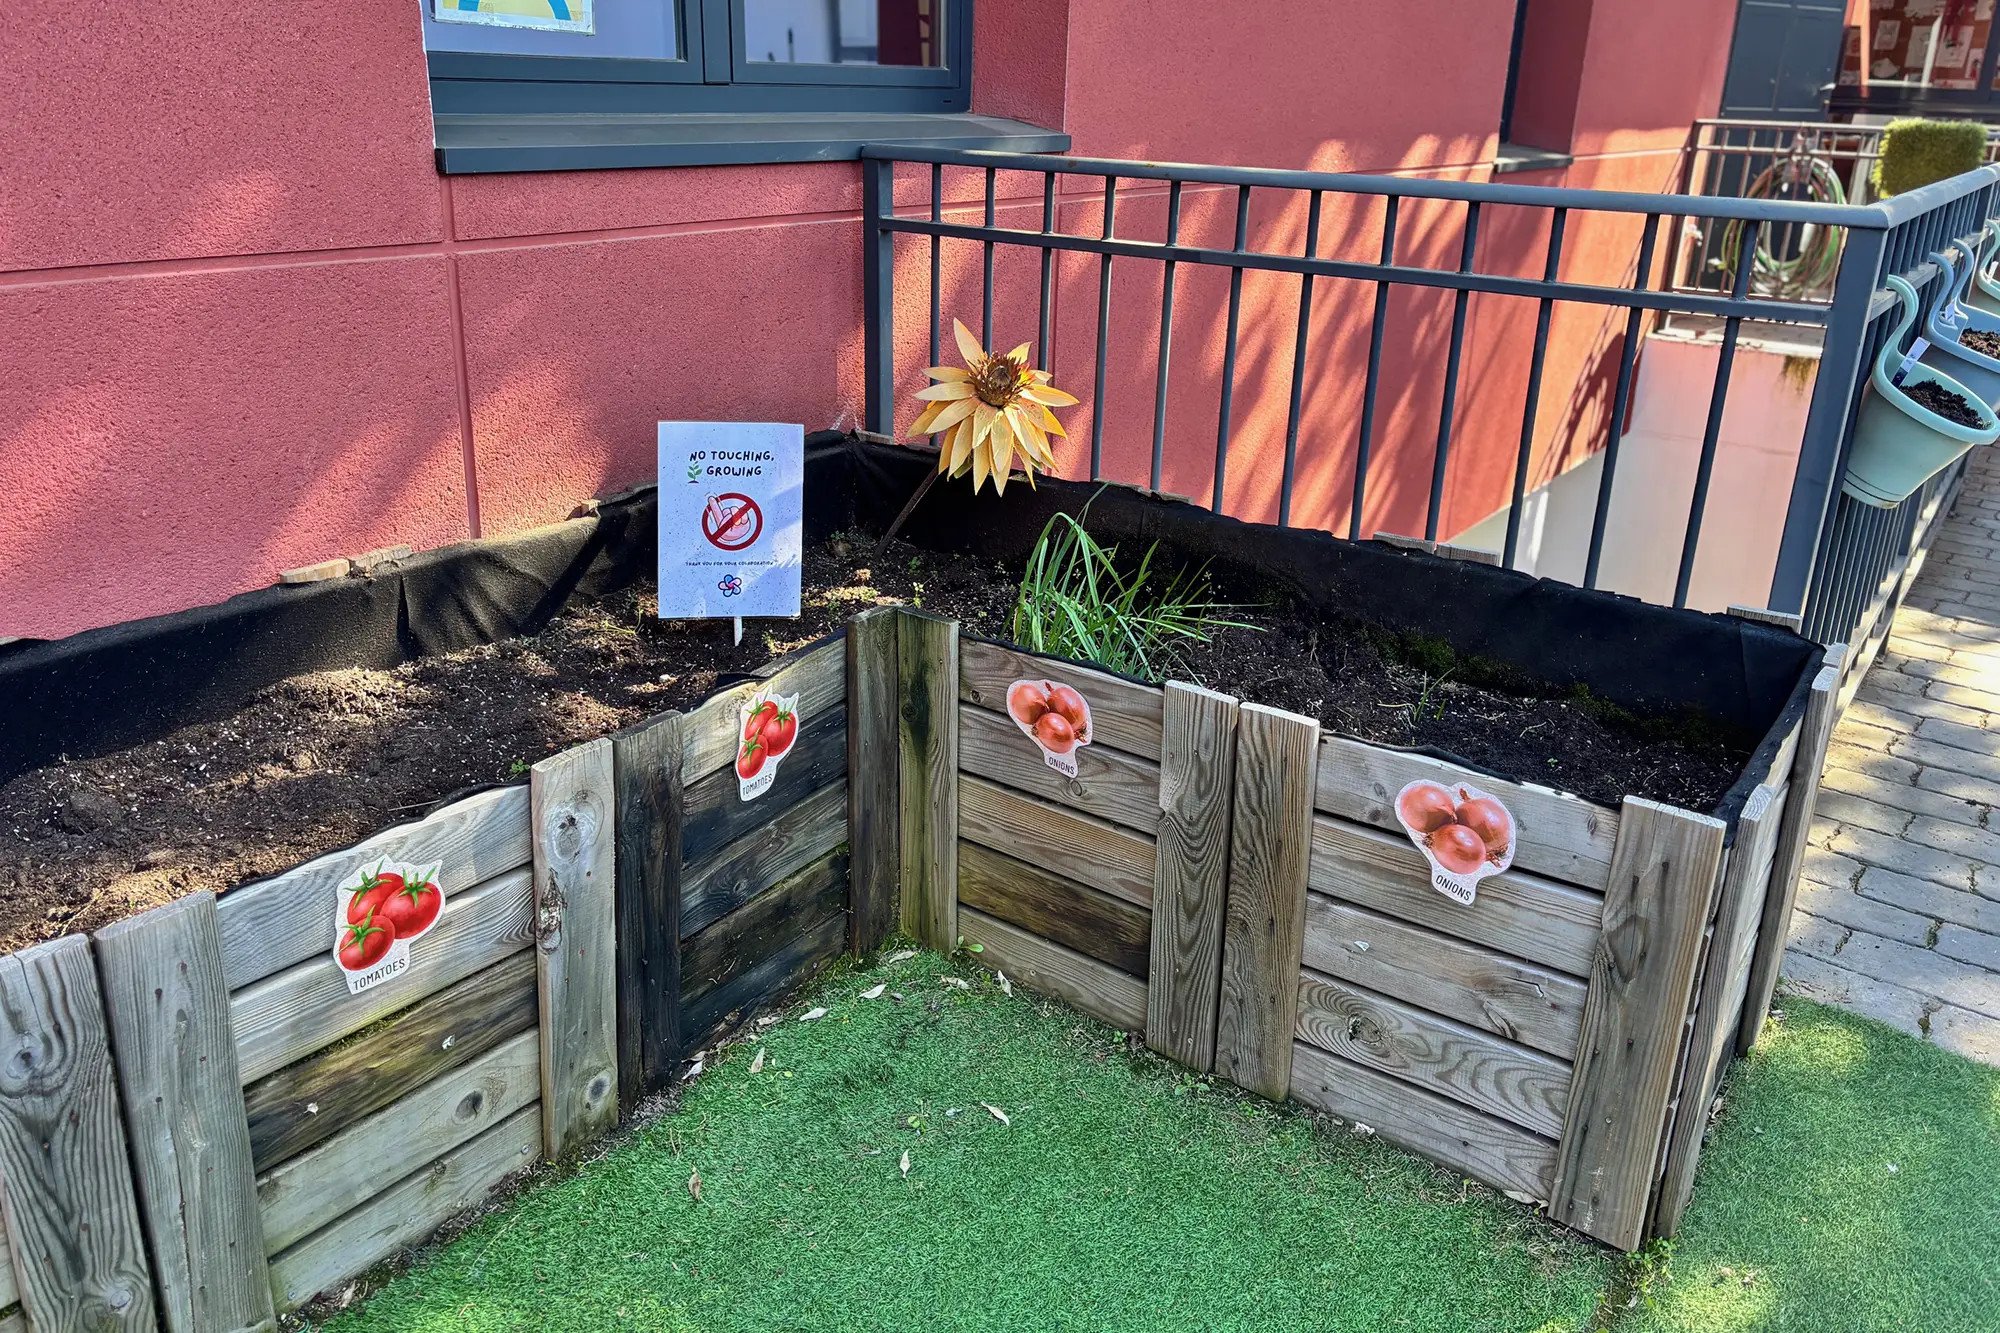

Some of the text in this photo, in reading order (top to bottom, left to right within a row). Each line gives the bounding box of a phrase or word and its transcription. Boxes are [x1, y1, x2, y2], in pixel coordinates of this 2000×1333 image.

[690, 451, 774, 462] NO TOUCHING,
[706, 466, 762, 477] GROWING
[1048, 757, 1075, 775] ONIONS
[742, 773, 772, 795] TOMATOES
[1436, 875, 1471, 900] ONIONS
[354, 958, 405, 990] TOMATOES
